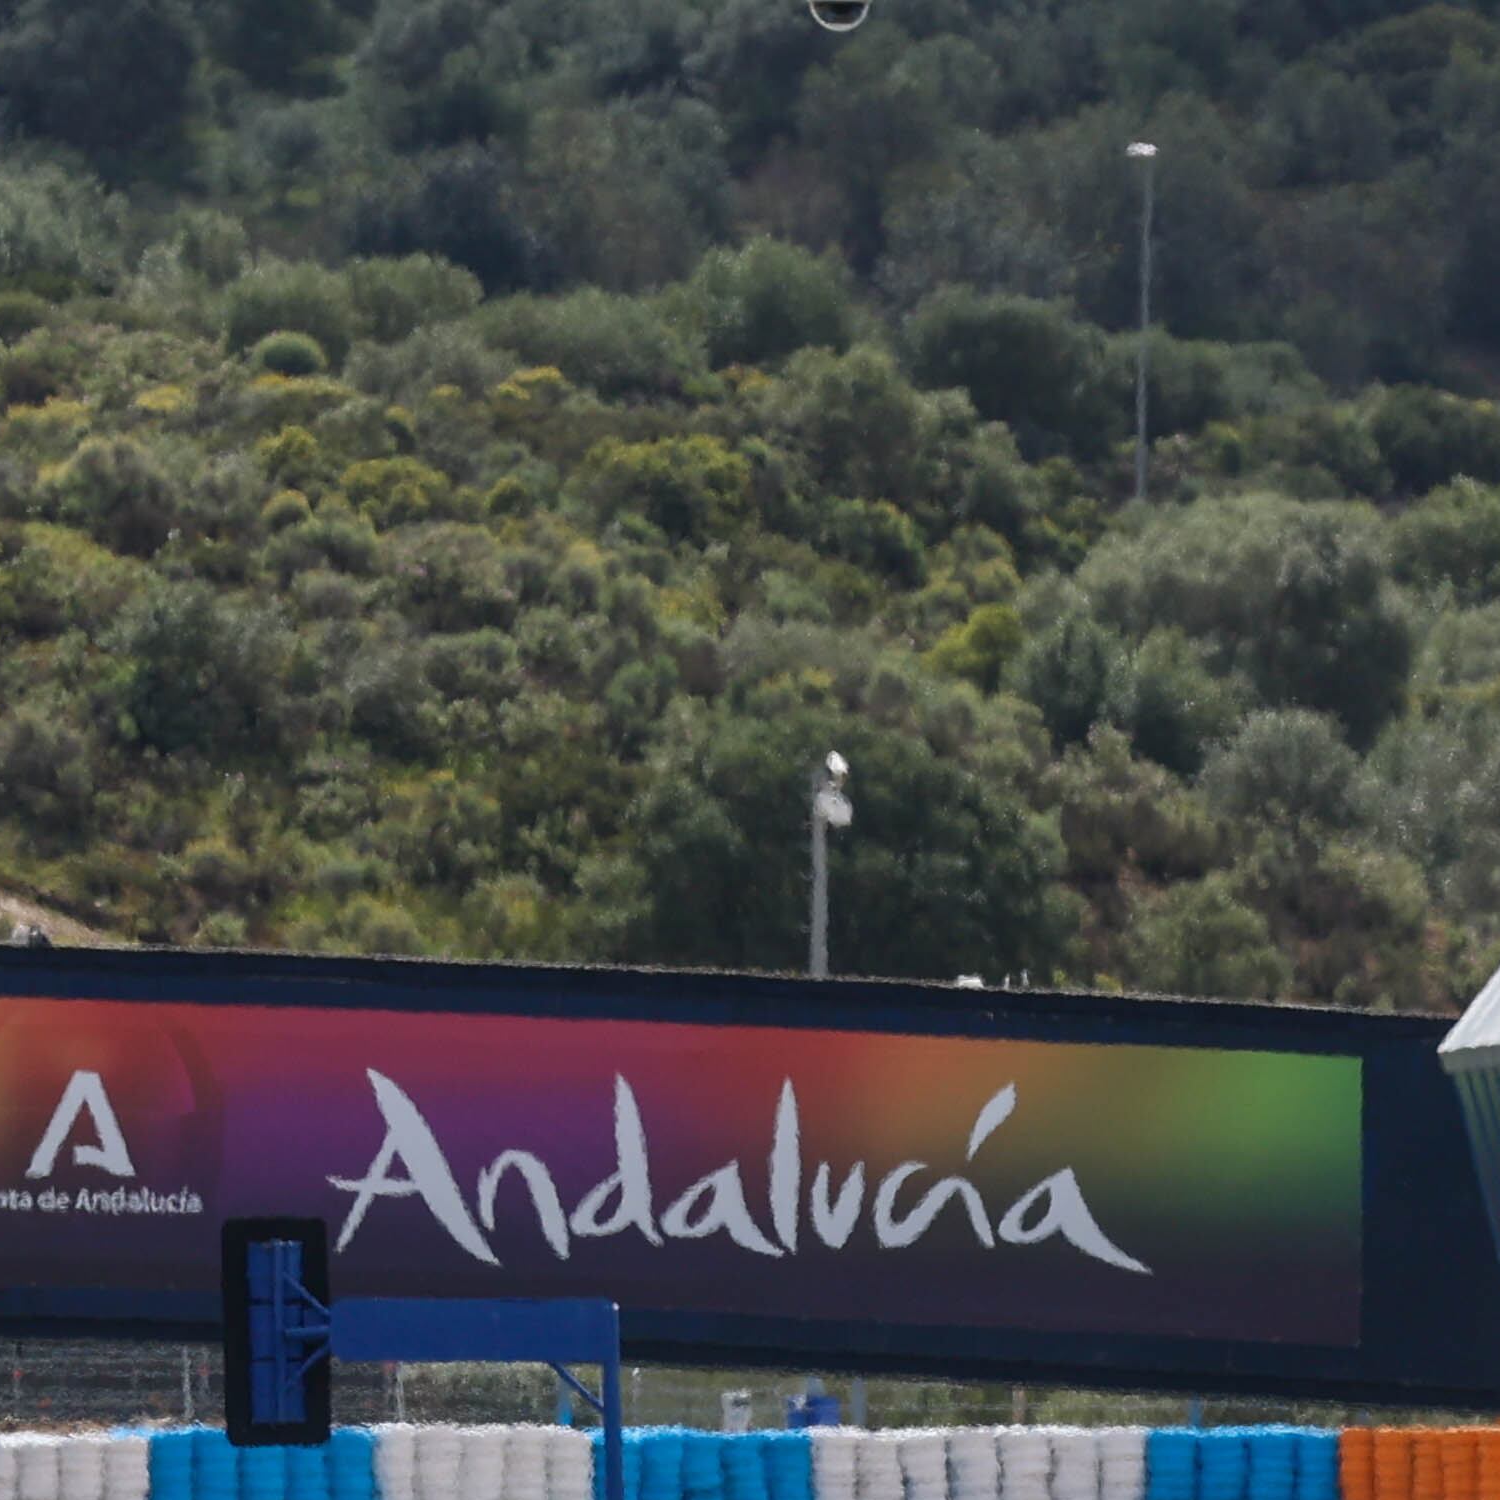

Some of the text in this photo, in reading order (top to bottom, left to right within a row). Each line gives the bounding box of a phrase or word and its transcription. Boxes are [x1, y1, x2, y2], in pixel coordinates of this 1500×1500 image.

[37, 1185, 70, 1211] de
[74, 1185, 203, 1216] Andalucía
[326, 1066, 1153, 1274] Andalucía
